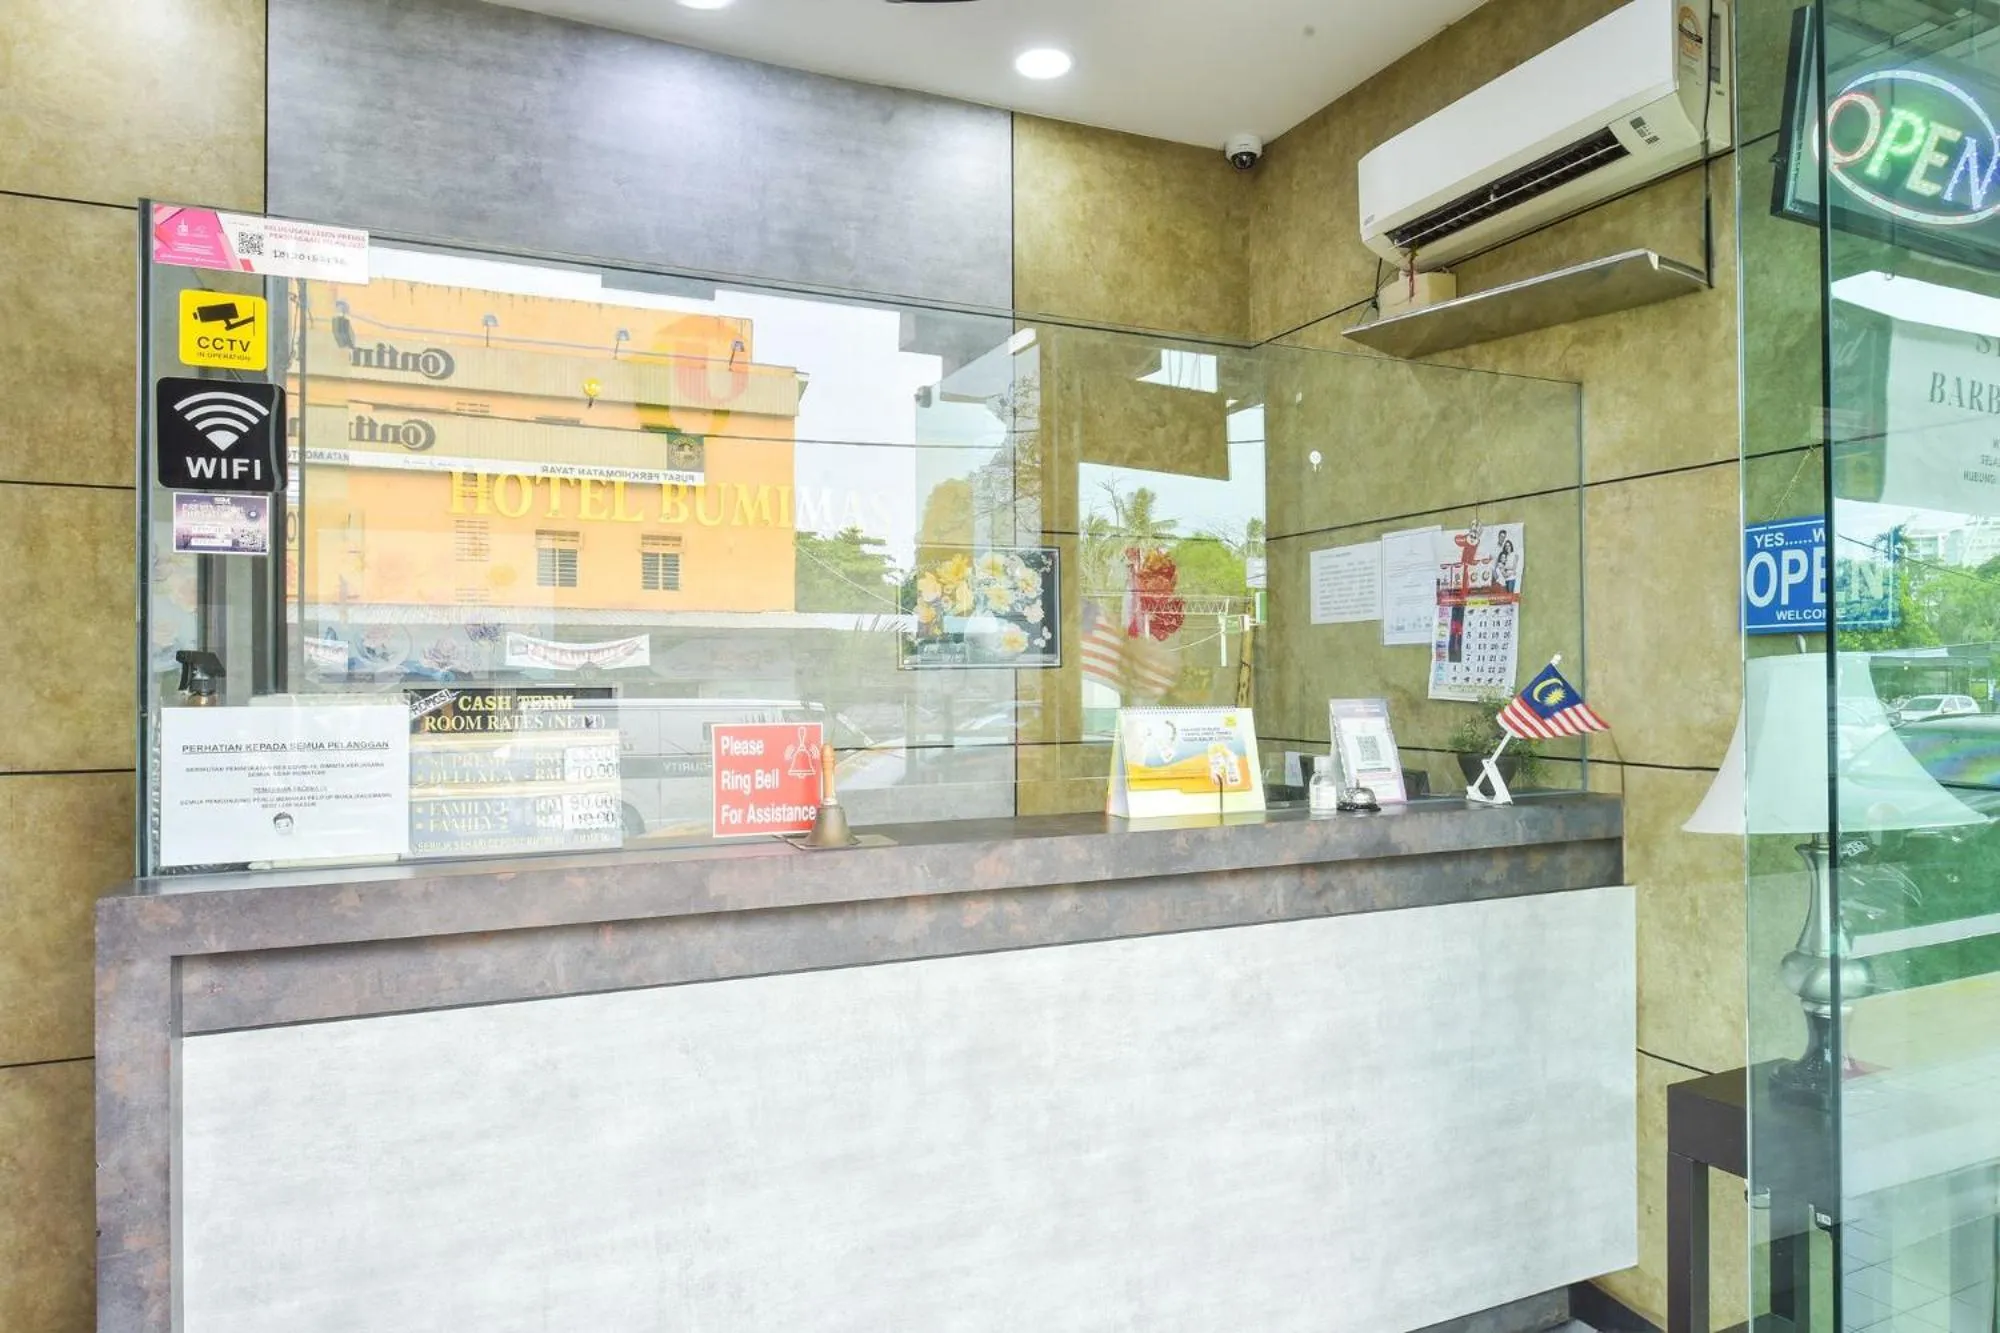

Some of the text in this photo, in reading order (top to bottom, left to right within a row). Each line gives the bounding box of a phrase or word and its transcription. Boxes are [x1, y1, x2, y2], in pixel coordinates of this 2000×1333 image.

[1827, 93, 2000, 211] OPEN
[196, 336, 251, 353] CCTV
[207, 352, 251, 362] OPERATION
[186, 456, 261, 481] WIFI
[449, 468, 893, 530] HOTEL BUMIMAS
[458, 695, 574, 712] CASH TERM
[424, 716, 482, 732] ROOM
[487, 716, 543, 731] RATES
[182, 740, 389, 754] PERHATIAN KEPADA SEMUA PELANGGAN
[720, 735, 764, 756] Please
[573, 763, 614, 780] 70.00
[720, 769, 780, 794] Ring Bell
[430, 801, 493, 817] FAMILY
[535, 799, 562, 813] RM
[720, 802, 816, 825] For Assistance
[430, 815, 493, 833] FAMILY
